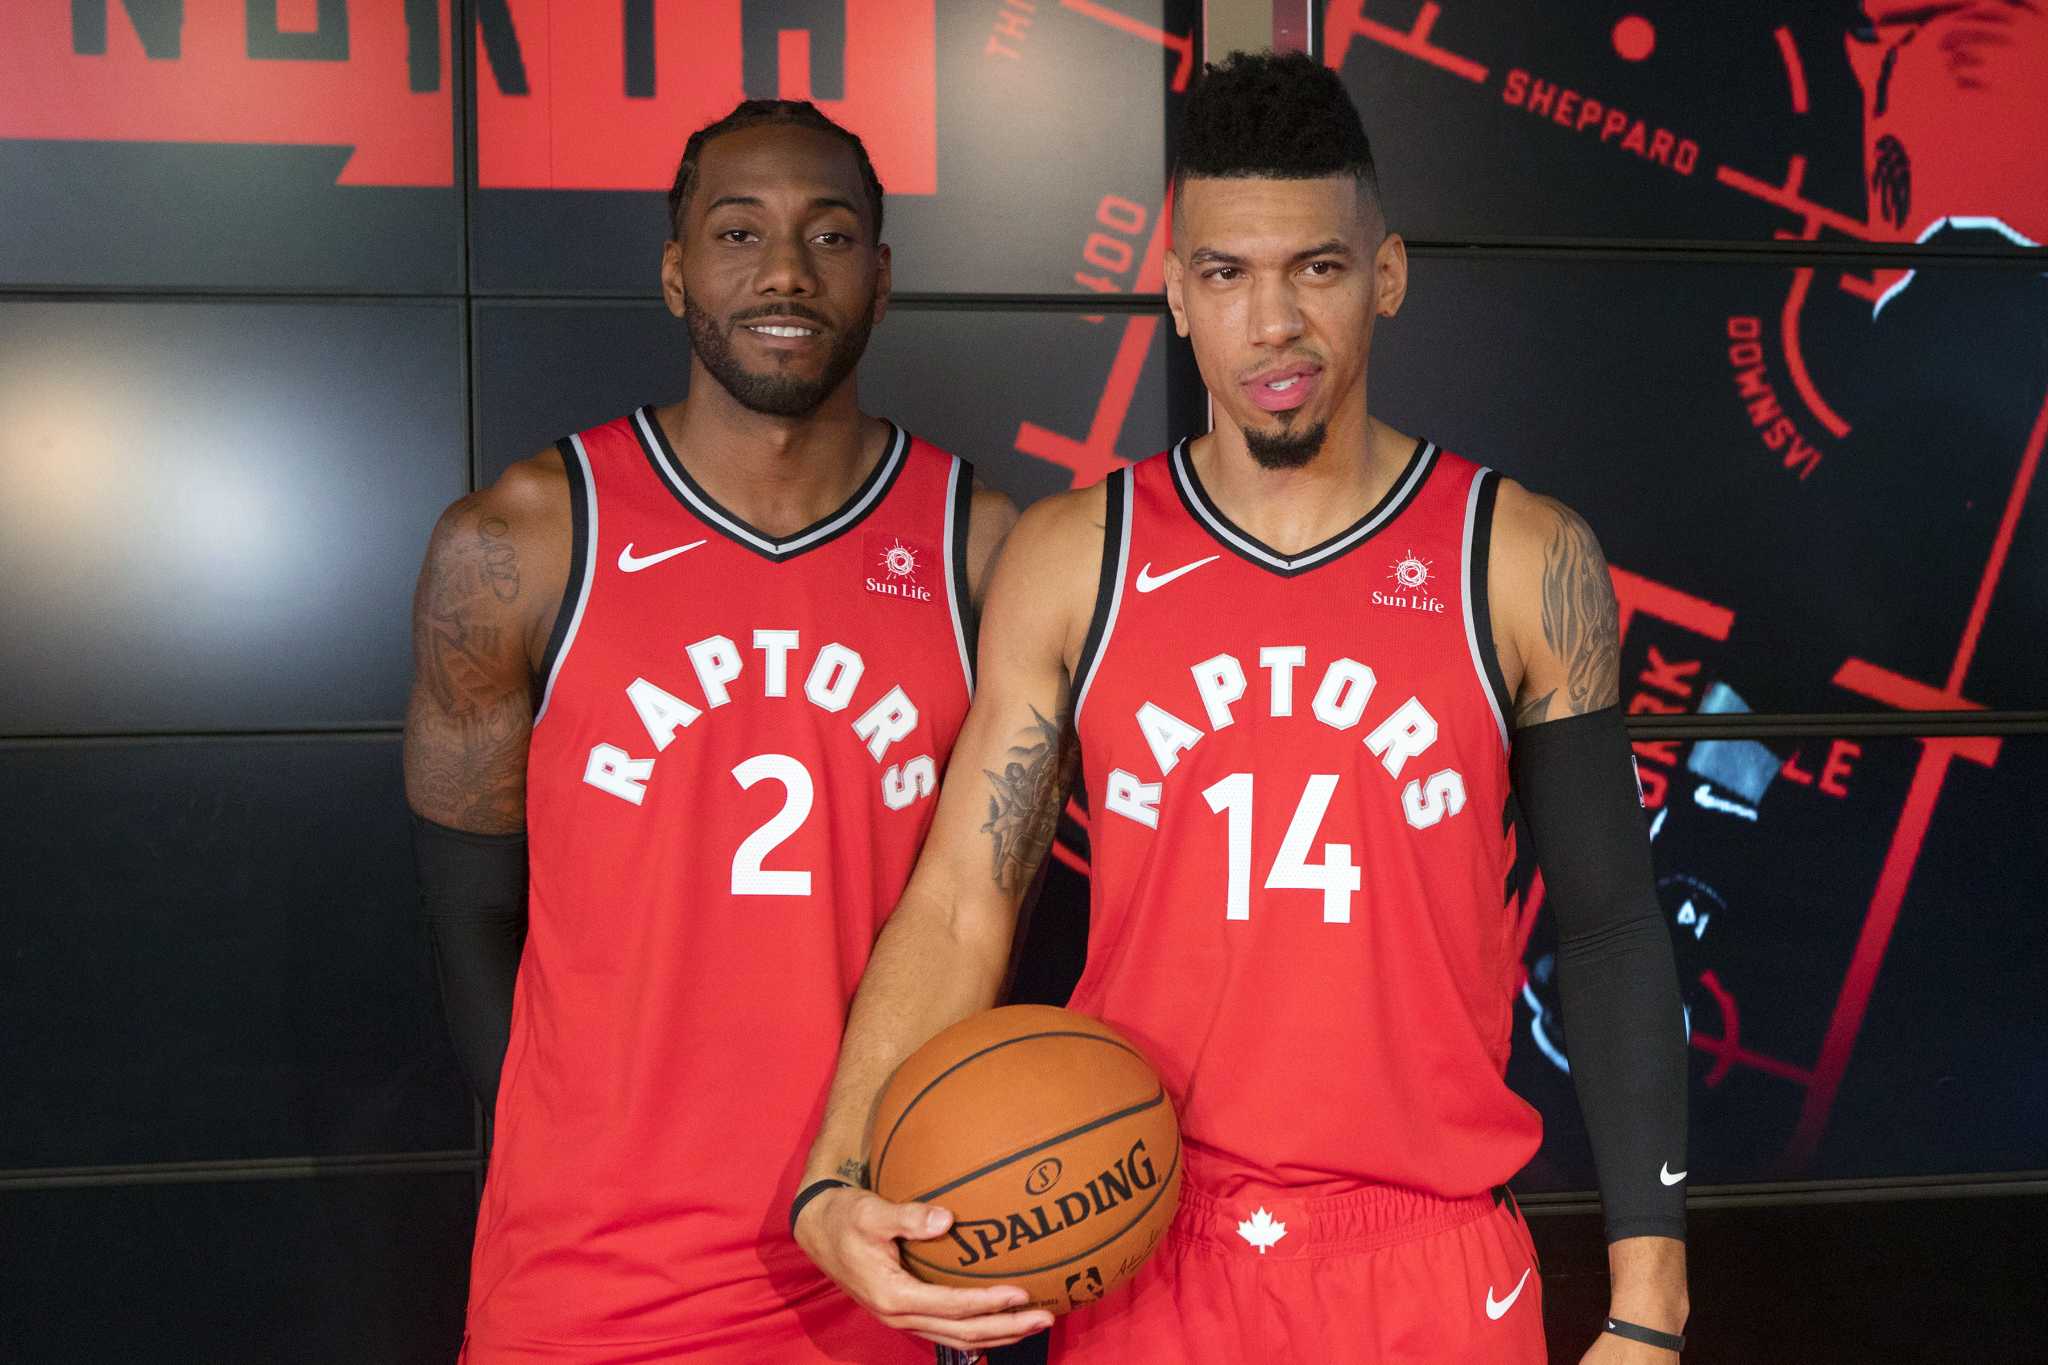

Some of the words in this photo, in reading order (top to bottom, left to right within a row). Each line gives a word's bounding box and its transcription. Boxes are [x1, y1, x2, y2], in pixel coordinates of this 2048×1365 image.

[1503, 67, 1700, 176] SHEPPARD
[866, 577, 898, 596] Sun
[902, 583, 932, 602] Life
[1371, 590, 1408, 608] Sun
[1411, 595, 1446, 614] Life
[582, 629, 937, 811] RAPTORS
[1104, 645, 1468, 831] RAPTORS
[730, 753, 814, 896] 2
[1201, 772, 1362, 924] 14
[948, 1137, 1158, 1267] SPALDING
